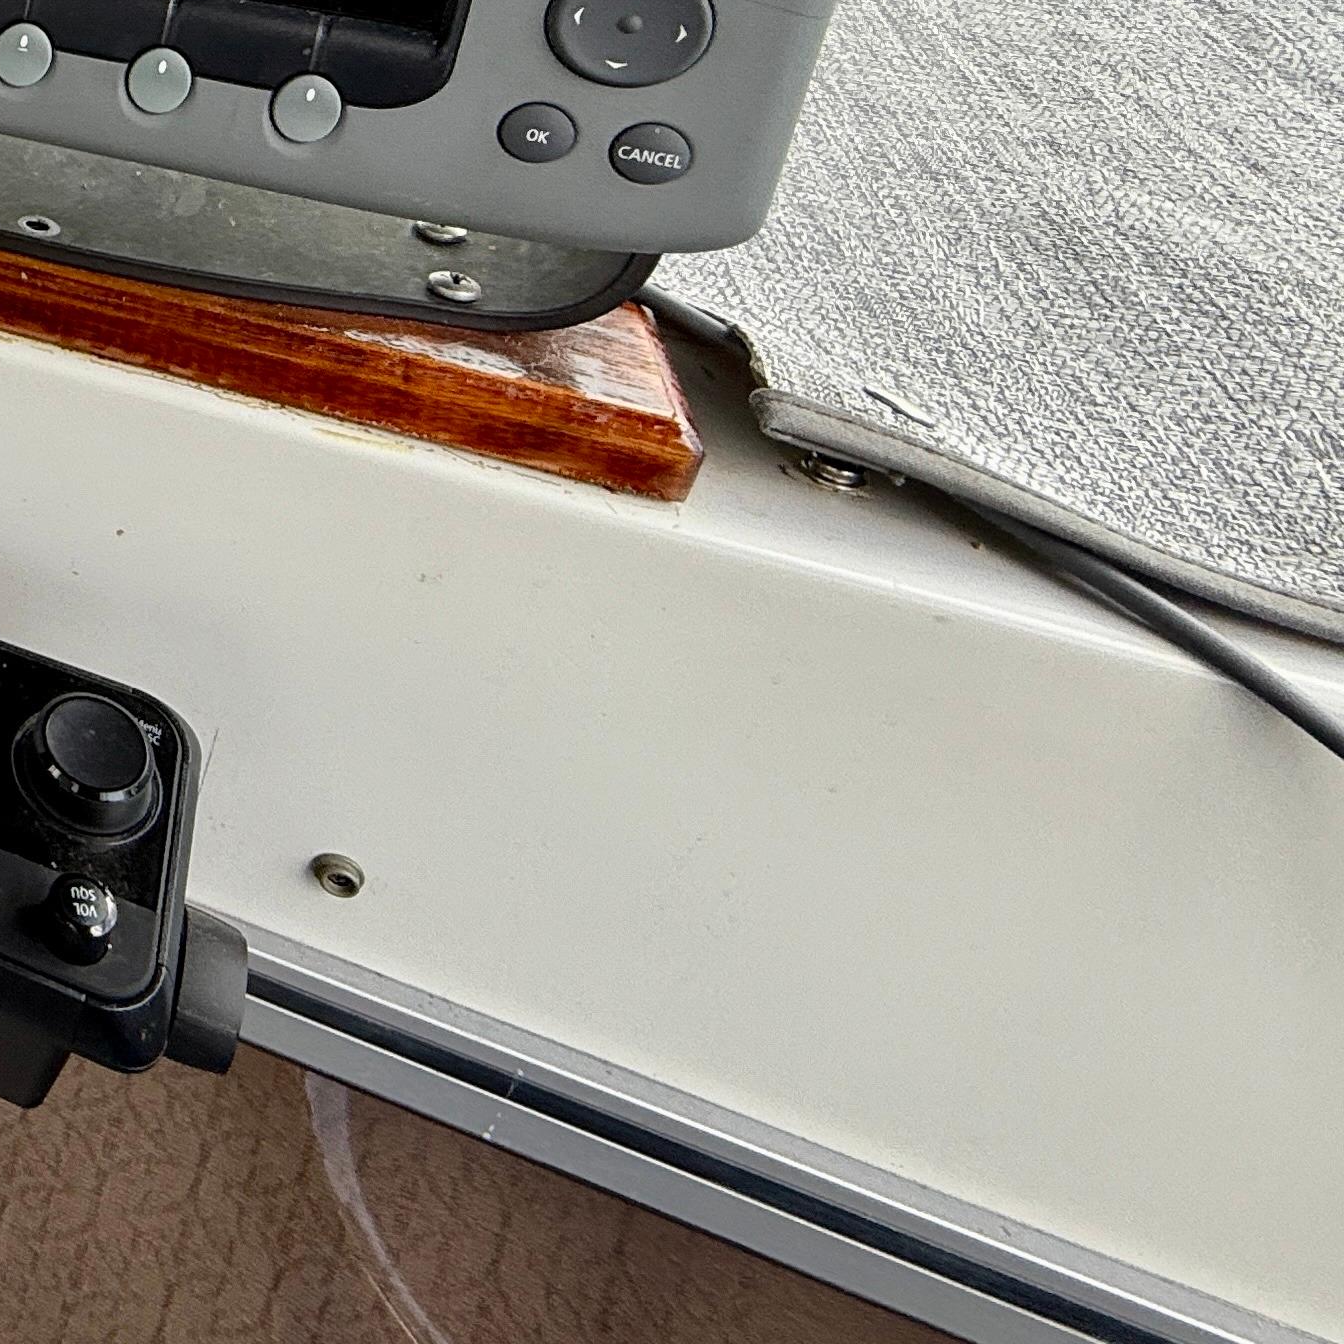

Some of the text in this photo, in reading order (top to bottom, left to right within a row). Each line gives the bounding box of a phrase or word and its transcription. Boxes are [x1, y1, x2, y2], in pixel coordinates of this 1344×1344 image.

[526, 128, 551, 145] OK
[617, 145, 683, 170] CANCEL
[73, 902, 97, 918] VOL
